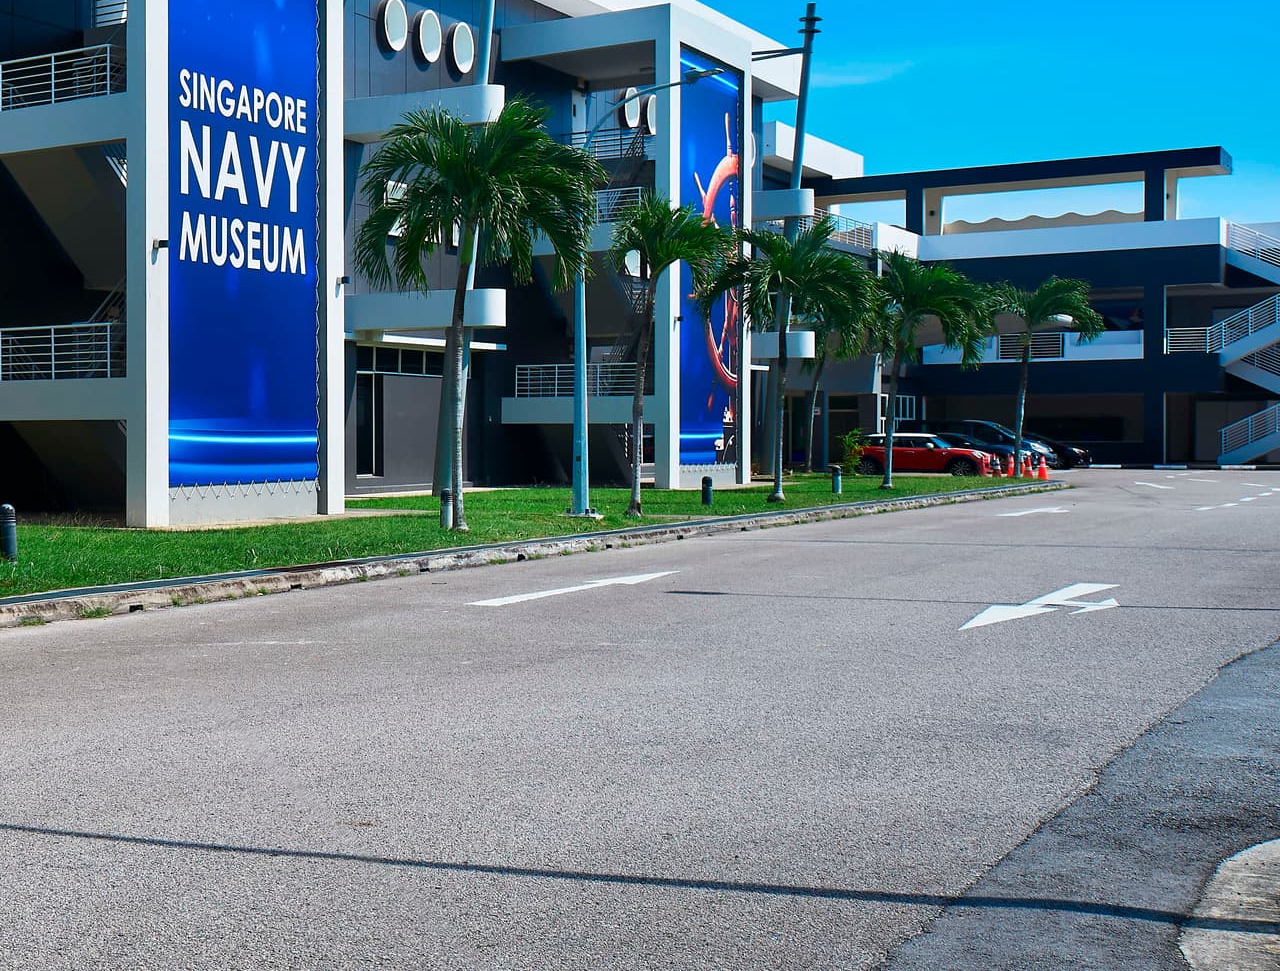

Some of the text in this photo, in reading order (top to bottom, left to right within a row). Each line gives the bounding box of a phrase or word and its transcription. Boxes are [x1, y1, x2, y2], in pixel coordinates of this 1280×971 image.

[179, 68, 307, 134] SINGAPORE
[179, 120, 306, 213] NAVY
[179, 211, 307, 275] MUSEUM
